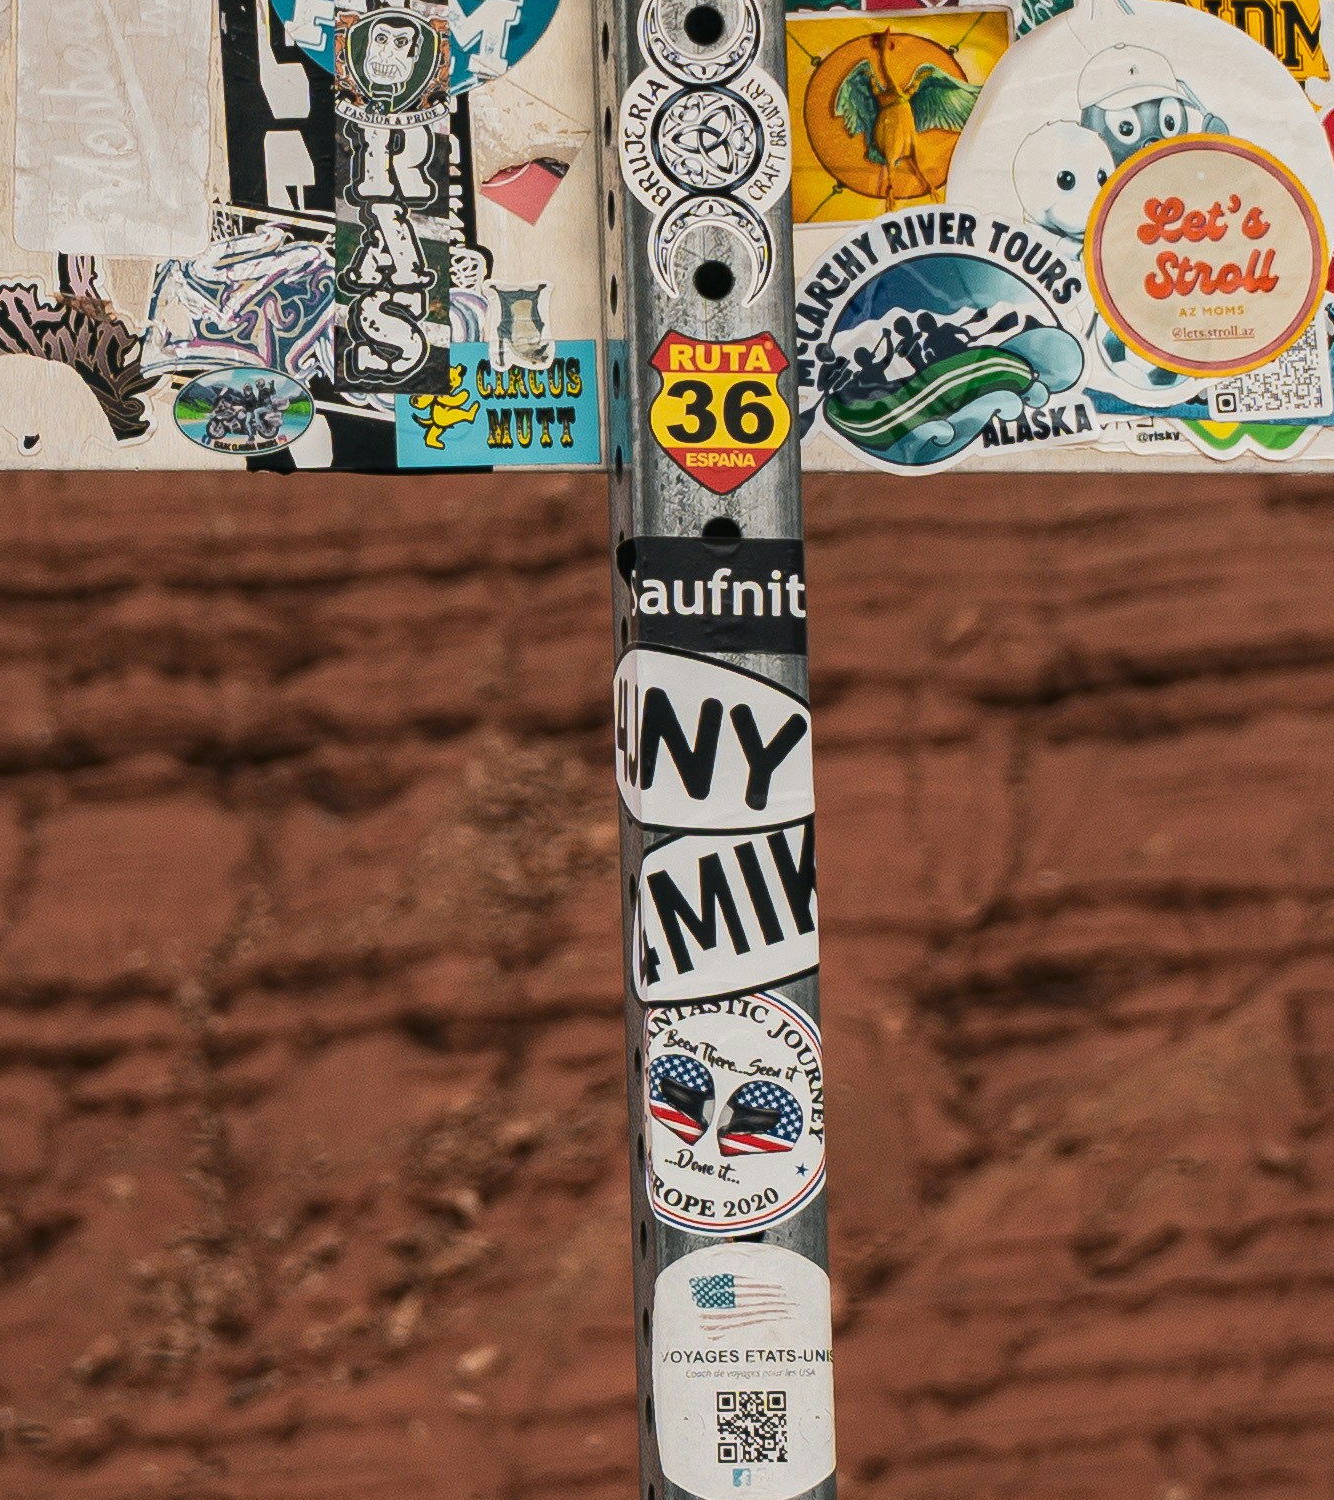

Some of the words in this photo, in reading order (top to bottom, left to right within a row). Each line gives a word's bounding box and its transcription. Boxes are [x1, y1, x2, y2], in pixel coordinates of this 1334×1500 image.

[395, 116, 402, 125] &
[406, 107, 439, 125] PRIDE
[740, 78, 787, 147] BREWERY
[747, 152, 786, 201] CRAFT
[1136, 194, 1271, 245] Let's
[881, 212, 977, 254] RIVER
[988, 220, 1082, 304] TOURS
[1144, 248, 1279, 300] Stroll
[1179, 306, 1196, 317] AZ
[1202, 305, 1245, 317] MOMS
[476, 357, 582, 399] CIRCUS
[669, 344, 771, 371] RUTA
[486, 406, 575, 449] MUTT
[666, 380, 775, 444] 36
[981, 403, 1093, 448] ALASKA
[685, 449, 756, 467] ESPAÑA
[631, 568, 806, 617] aufnit
[663, 1029, 698, 1055] Been
[723, 1187, 779, 1218] 2020
[798, 1368, 816, 1377] USA
